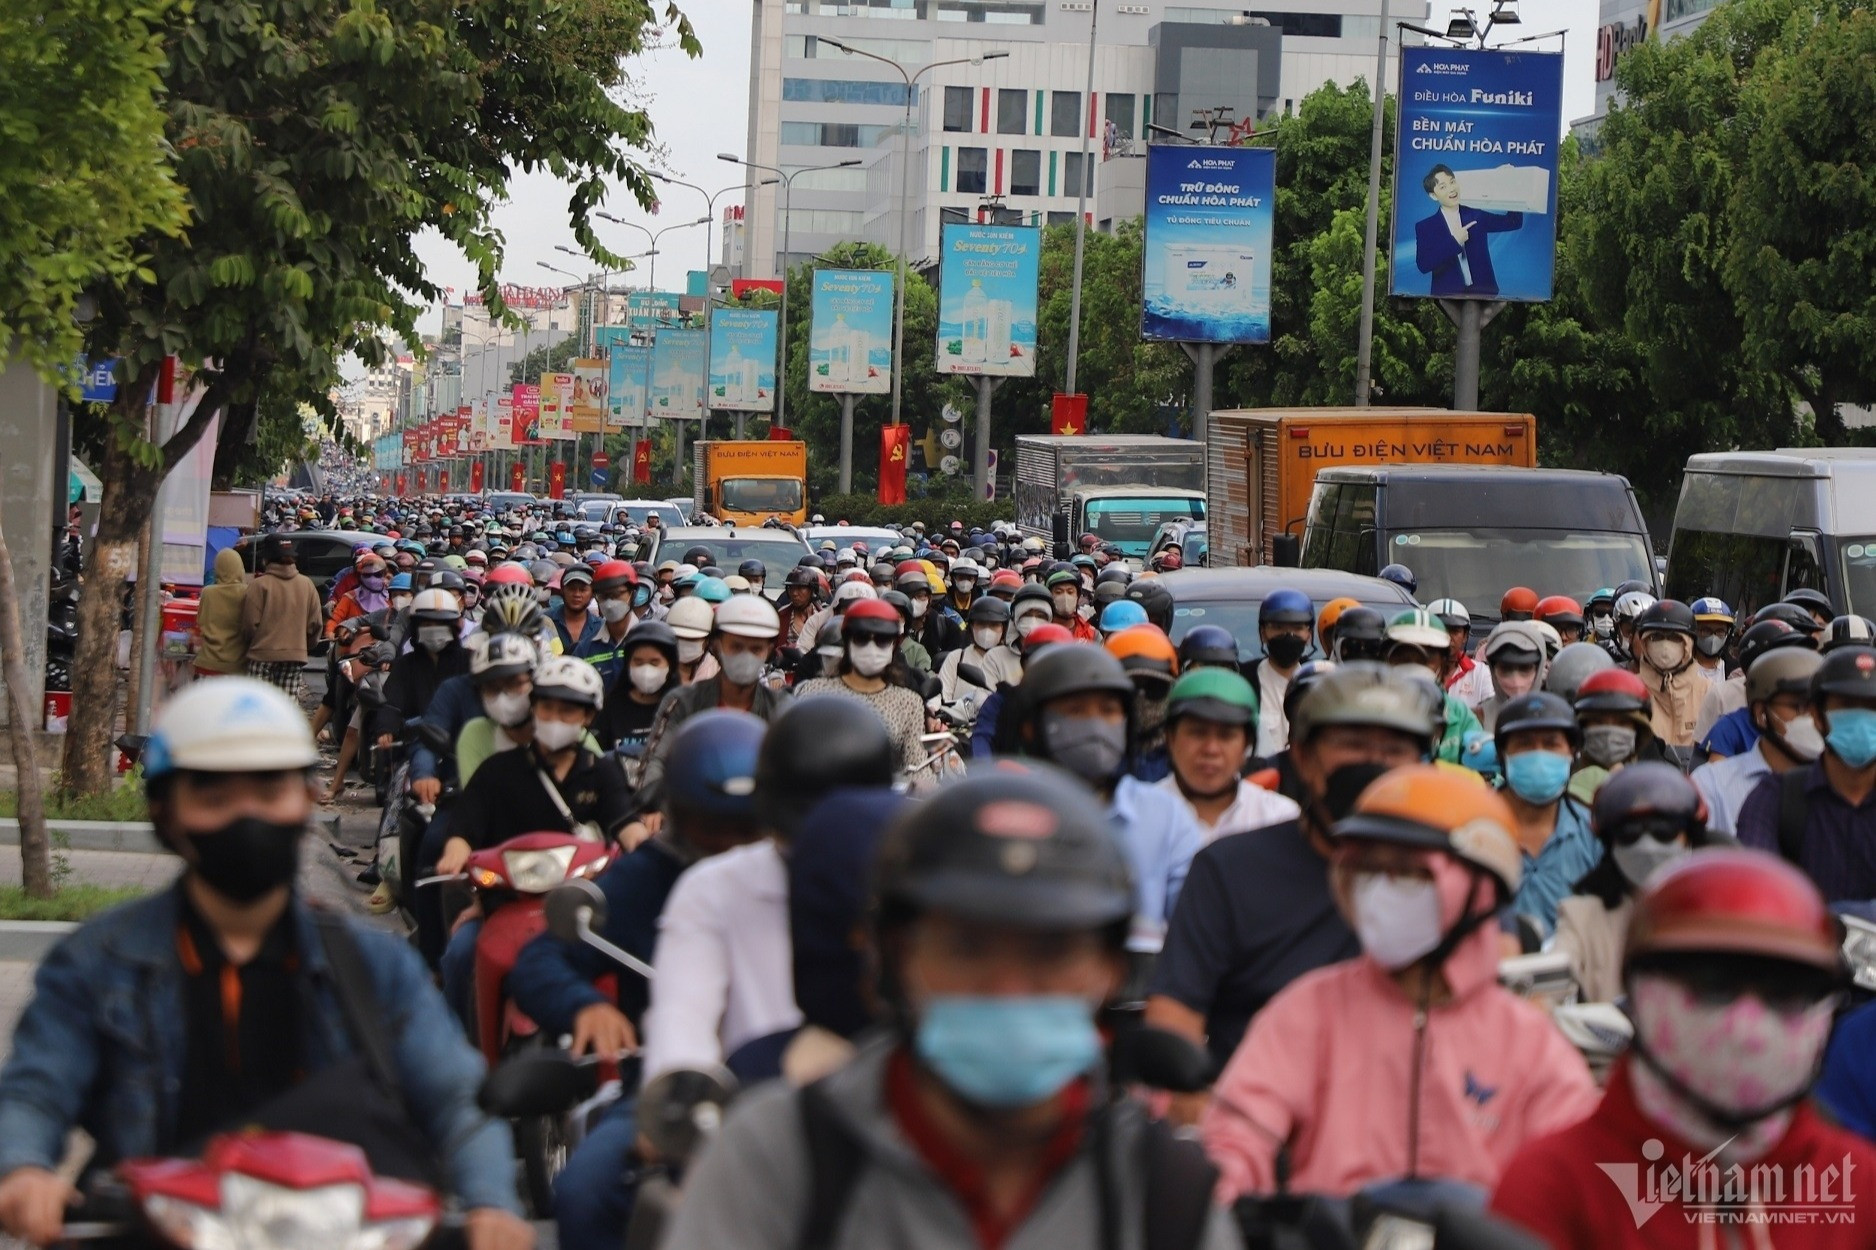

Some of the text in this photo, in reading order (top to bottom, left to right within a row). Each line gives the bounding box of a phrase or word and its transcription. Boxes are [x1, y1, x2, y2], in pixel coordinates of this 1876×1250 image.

[1414, 89, 1533, 105] ĐIỀU HÒA Funiki
[1413, 117, 1474, 133] BỀN MÁT
[1412, 134, 1545, 155] CHUẨN HÒA PHÁT
[1180, 182, 1240, 194] TRỮ ĐÔNG
[1229, 196, 1261, 207] PHÁT
[953, 240, 1001, 256] Seventy
[821, 282, 860, 294] Seventy
[719, 319, 751, 329] Seventy
[717, 450, 735, 458] BƯU
[738, 450, 757, 458] ĐIỆN
[760, 450, 777, 458] VIỆT
[1299, 439, 1513, 461] BƯU ĐIỆN VIỆT NAM
